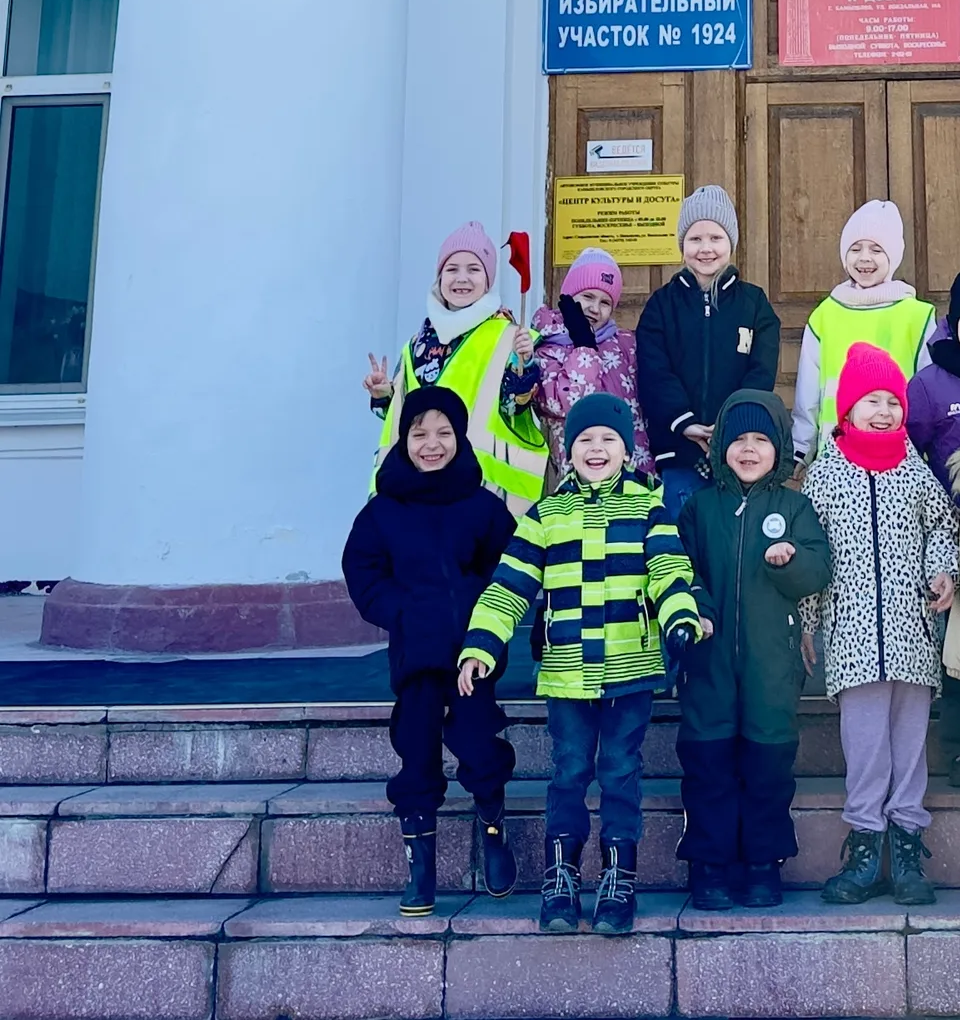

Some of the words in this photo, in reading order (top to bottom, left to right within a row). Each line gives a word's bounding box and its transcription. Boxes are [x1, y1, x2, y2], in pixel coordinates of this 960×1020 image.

[558, 23, 649, 48] УЧАСТОК
[659, 23, 681, 46] №
[691, 22, 736, 45] 1924
